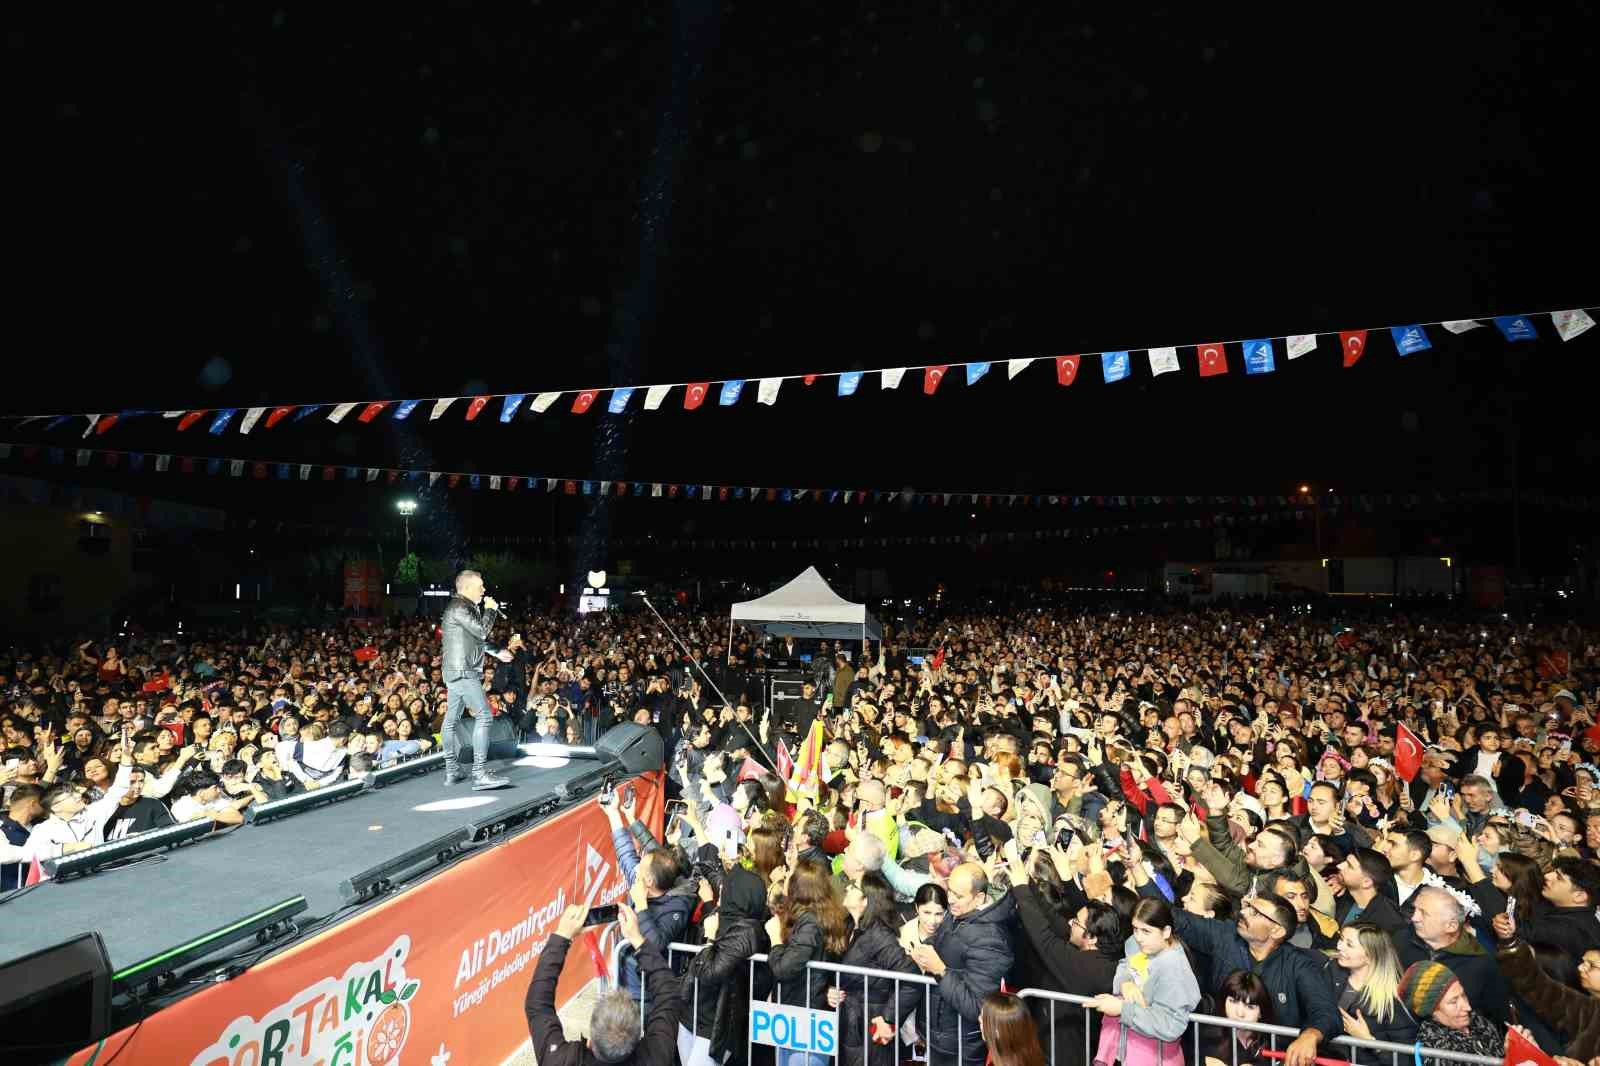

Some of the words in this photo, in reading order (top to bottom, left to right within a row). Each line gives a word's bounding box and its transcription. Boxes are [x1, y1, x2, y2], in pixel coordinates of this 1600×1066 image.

[454, 938, 485, 991] Ali
[485, 888, 566, 966] Demirçalı
[206, 959, 396, 1066] ORTAKAL
[752, 1009, 834, 1053] POLİS
